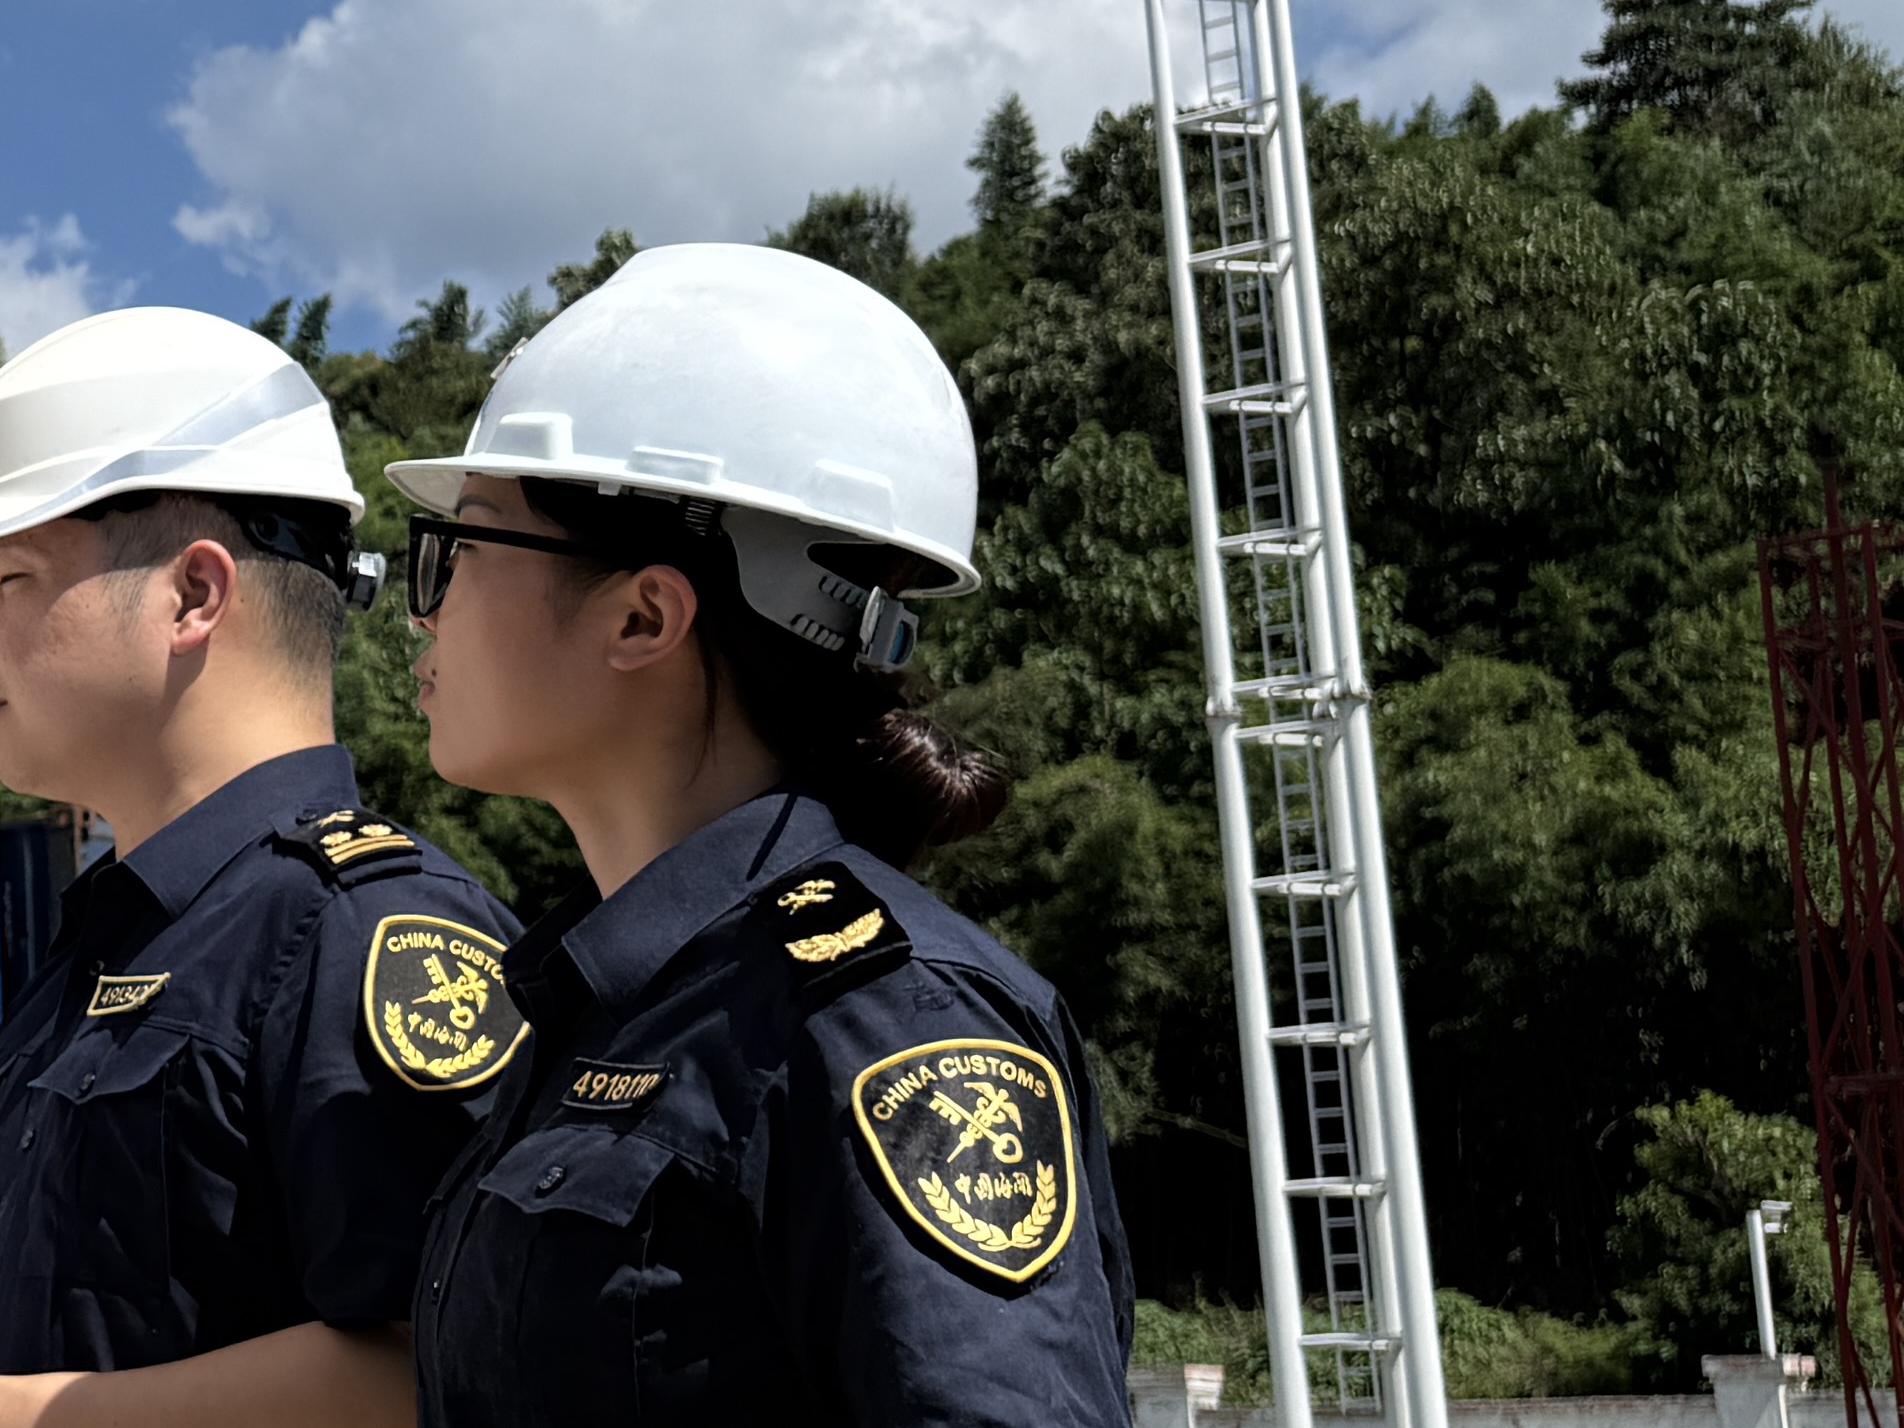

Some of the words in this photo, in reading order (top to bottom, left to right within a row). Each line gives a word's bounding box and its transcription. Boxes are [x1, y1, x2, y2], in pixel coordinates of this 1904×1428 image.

[386, 932, 446, 953] CHINA
[872, 1065, 938, 1121] CHINA
[938, 1055, 1047, 1099] CUSTOMS
[955, 1172, 1033, 1204] 中国海关
